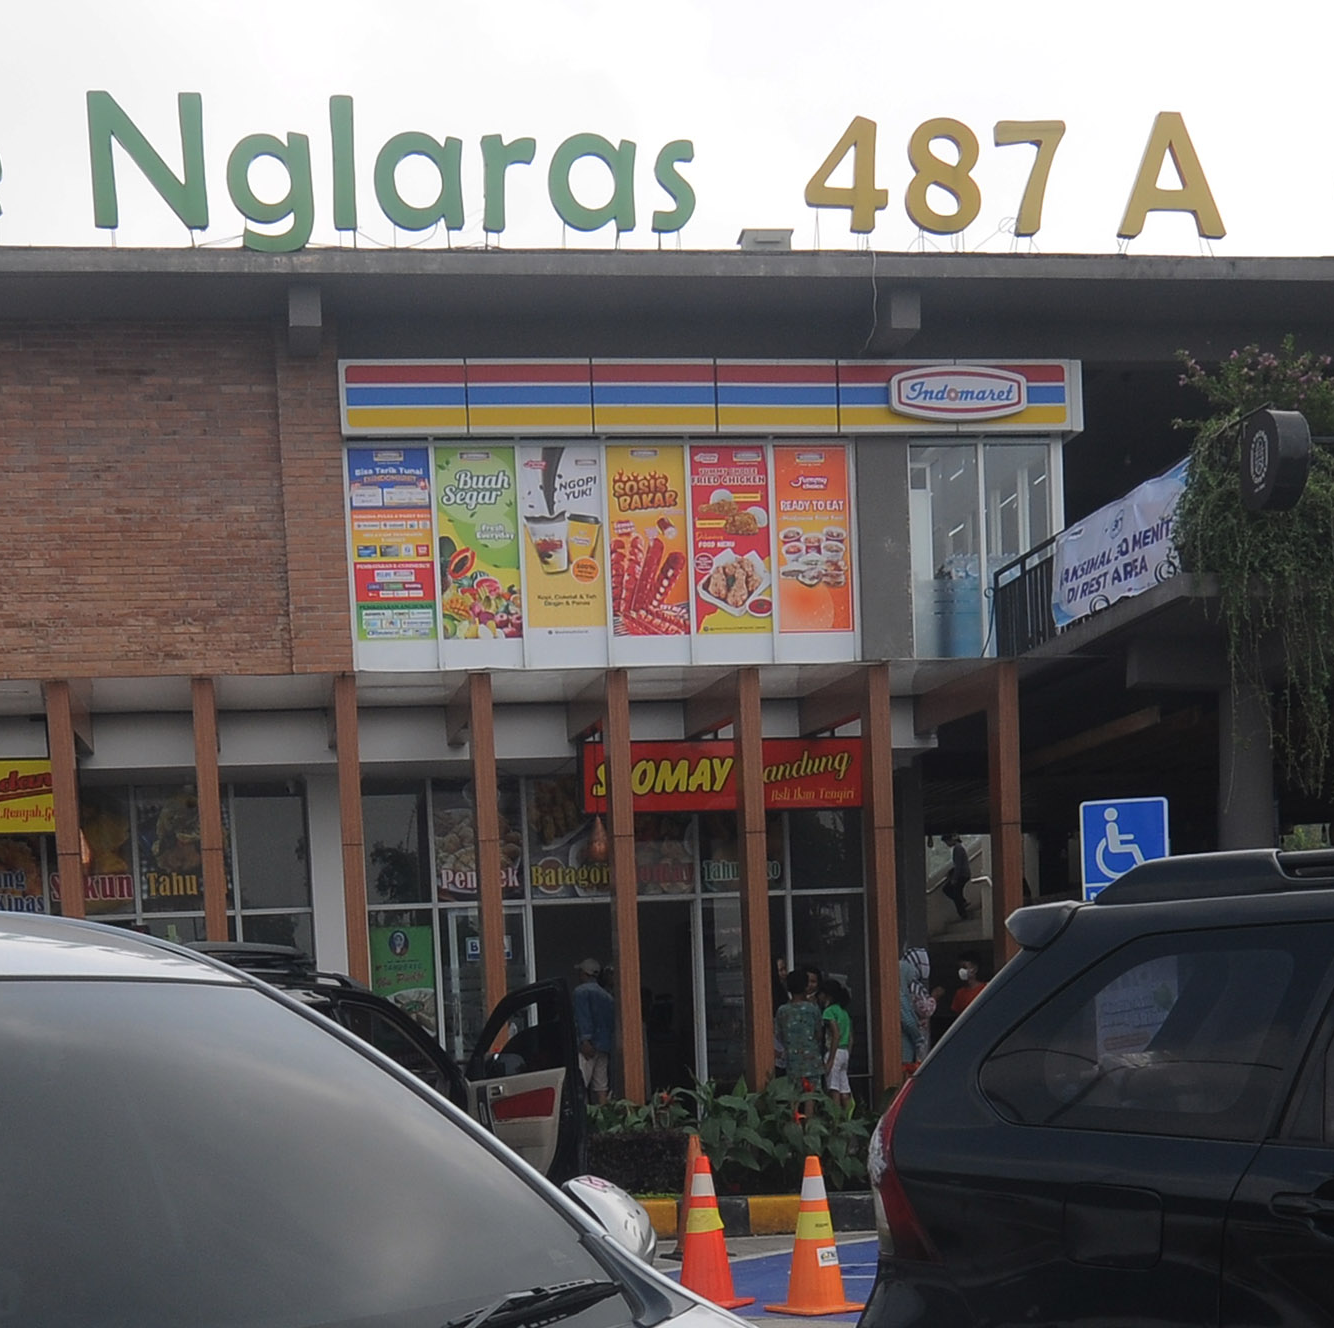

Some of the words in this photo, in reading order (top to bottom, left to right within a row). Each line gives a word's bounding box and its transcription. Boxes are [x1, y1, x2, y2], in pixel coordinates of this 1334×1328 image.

[86, 90, 696, 251] Nglaras
[805, 116, 1066, 237] 487
[1116, 111, 1227, 239] A
[906, 381, 1013, 401] Indomaret
[456, 469, 510, 489] Buah
[559, 475, 597, 492] NGOPI
[613, 477, 668, 496] SOSIS
[691, 475, 720, 485] FRIED
[721, 474, 766, 485] CHICKEN
[442, 484, 502, 510] Segar
[564, 487, 592, 501] YUK!
[618, 491, 678, 511] BAKAR
[780, 500, 810, 511] READY
[812, 500, 825, 511] TO
[826, 500, 844, 511] EAT
[1067, 585, 1080, 604] DI
[1079, 571, 1108, 599] REST
[1111, 554, 1148, 586] AREA
[592, 756, 734, 797] SOMAY
[762, 749, 853, 785] andung
[50, 871, 134, 901] Skun
[146, 872, 199, 897] Tahu
